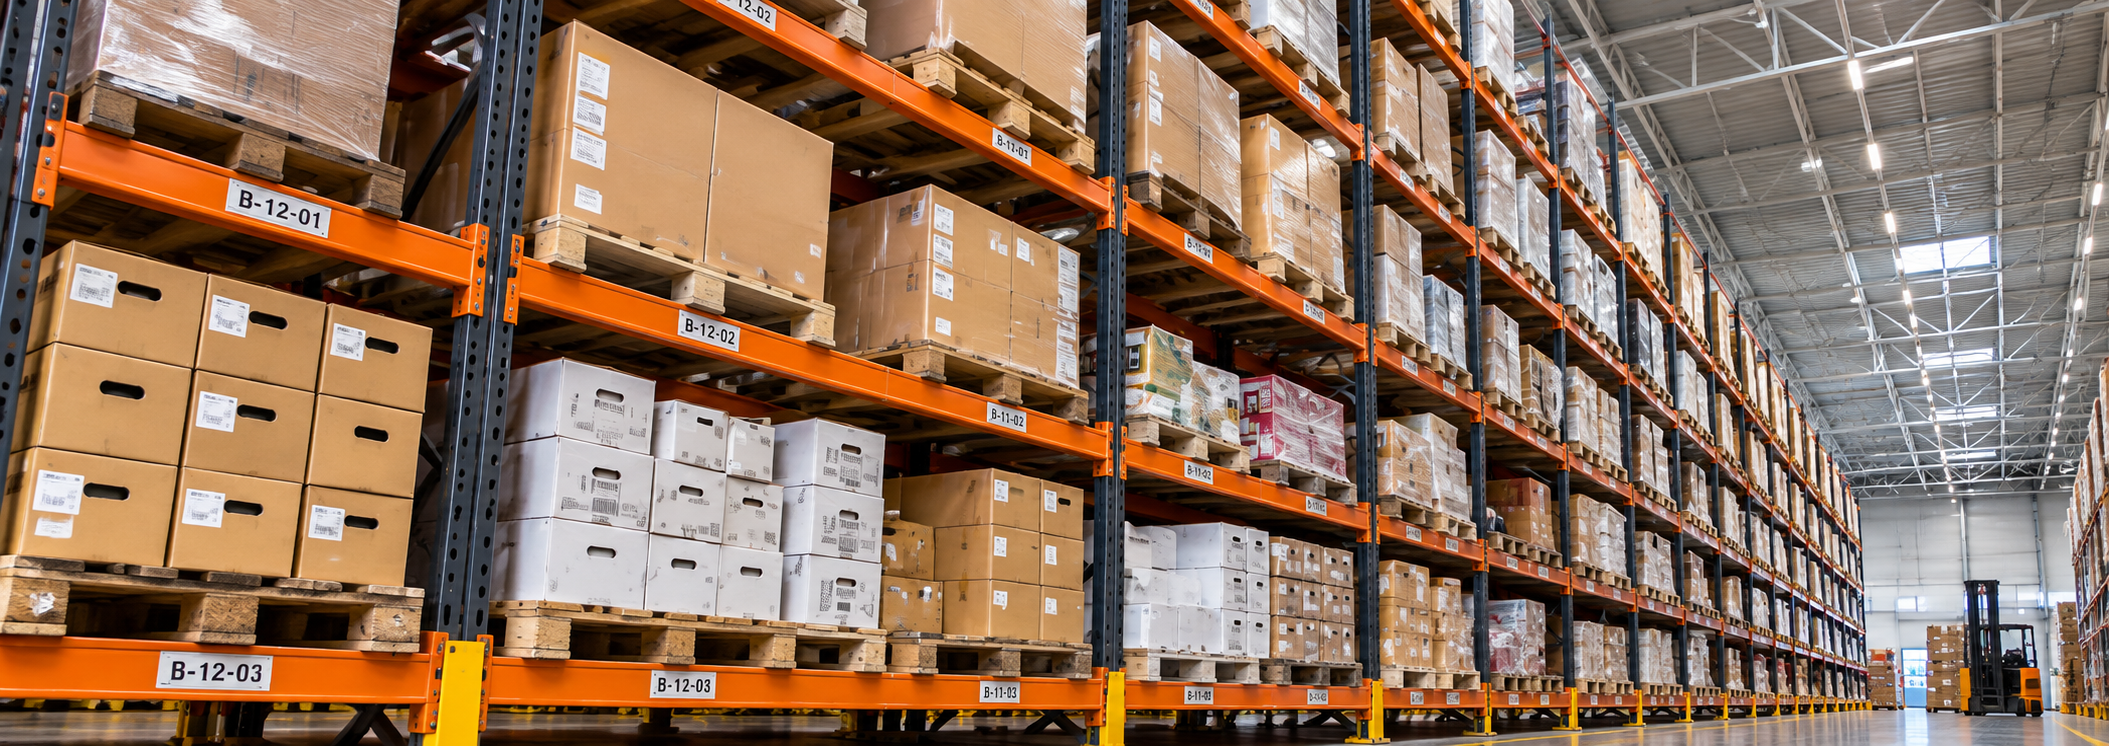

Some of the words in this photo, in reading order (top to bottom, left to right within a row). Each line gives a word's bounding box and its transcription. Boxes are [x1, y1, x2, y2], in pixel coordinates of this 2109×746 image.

[728, 0, 771, 24] 12-02
[239, 189, 320, 229] B-12-01
[685, 318, 735, 346] B-12-02
[991, 408, 1024, 427] B-11-02
[170, 660, 263, 683] B-12-03
[658, 677, 710, 693] B-12-03
[984, 686, 1017, 699] B-11-03
